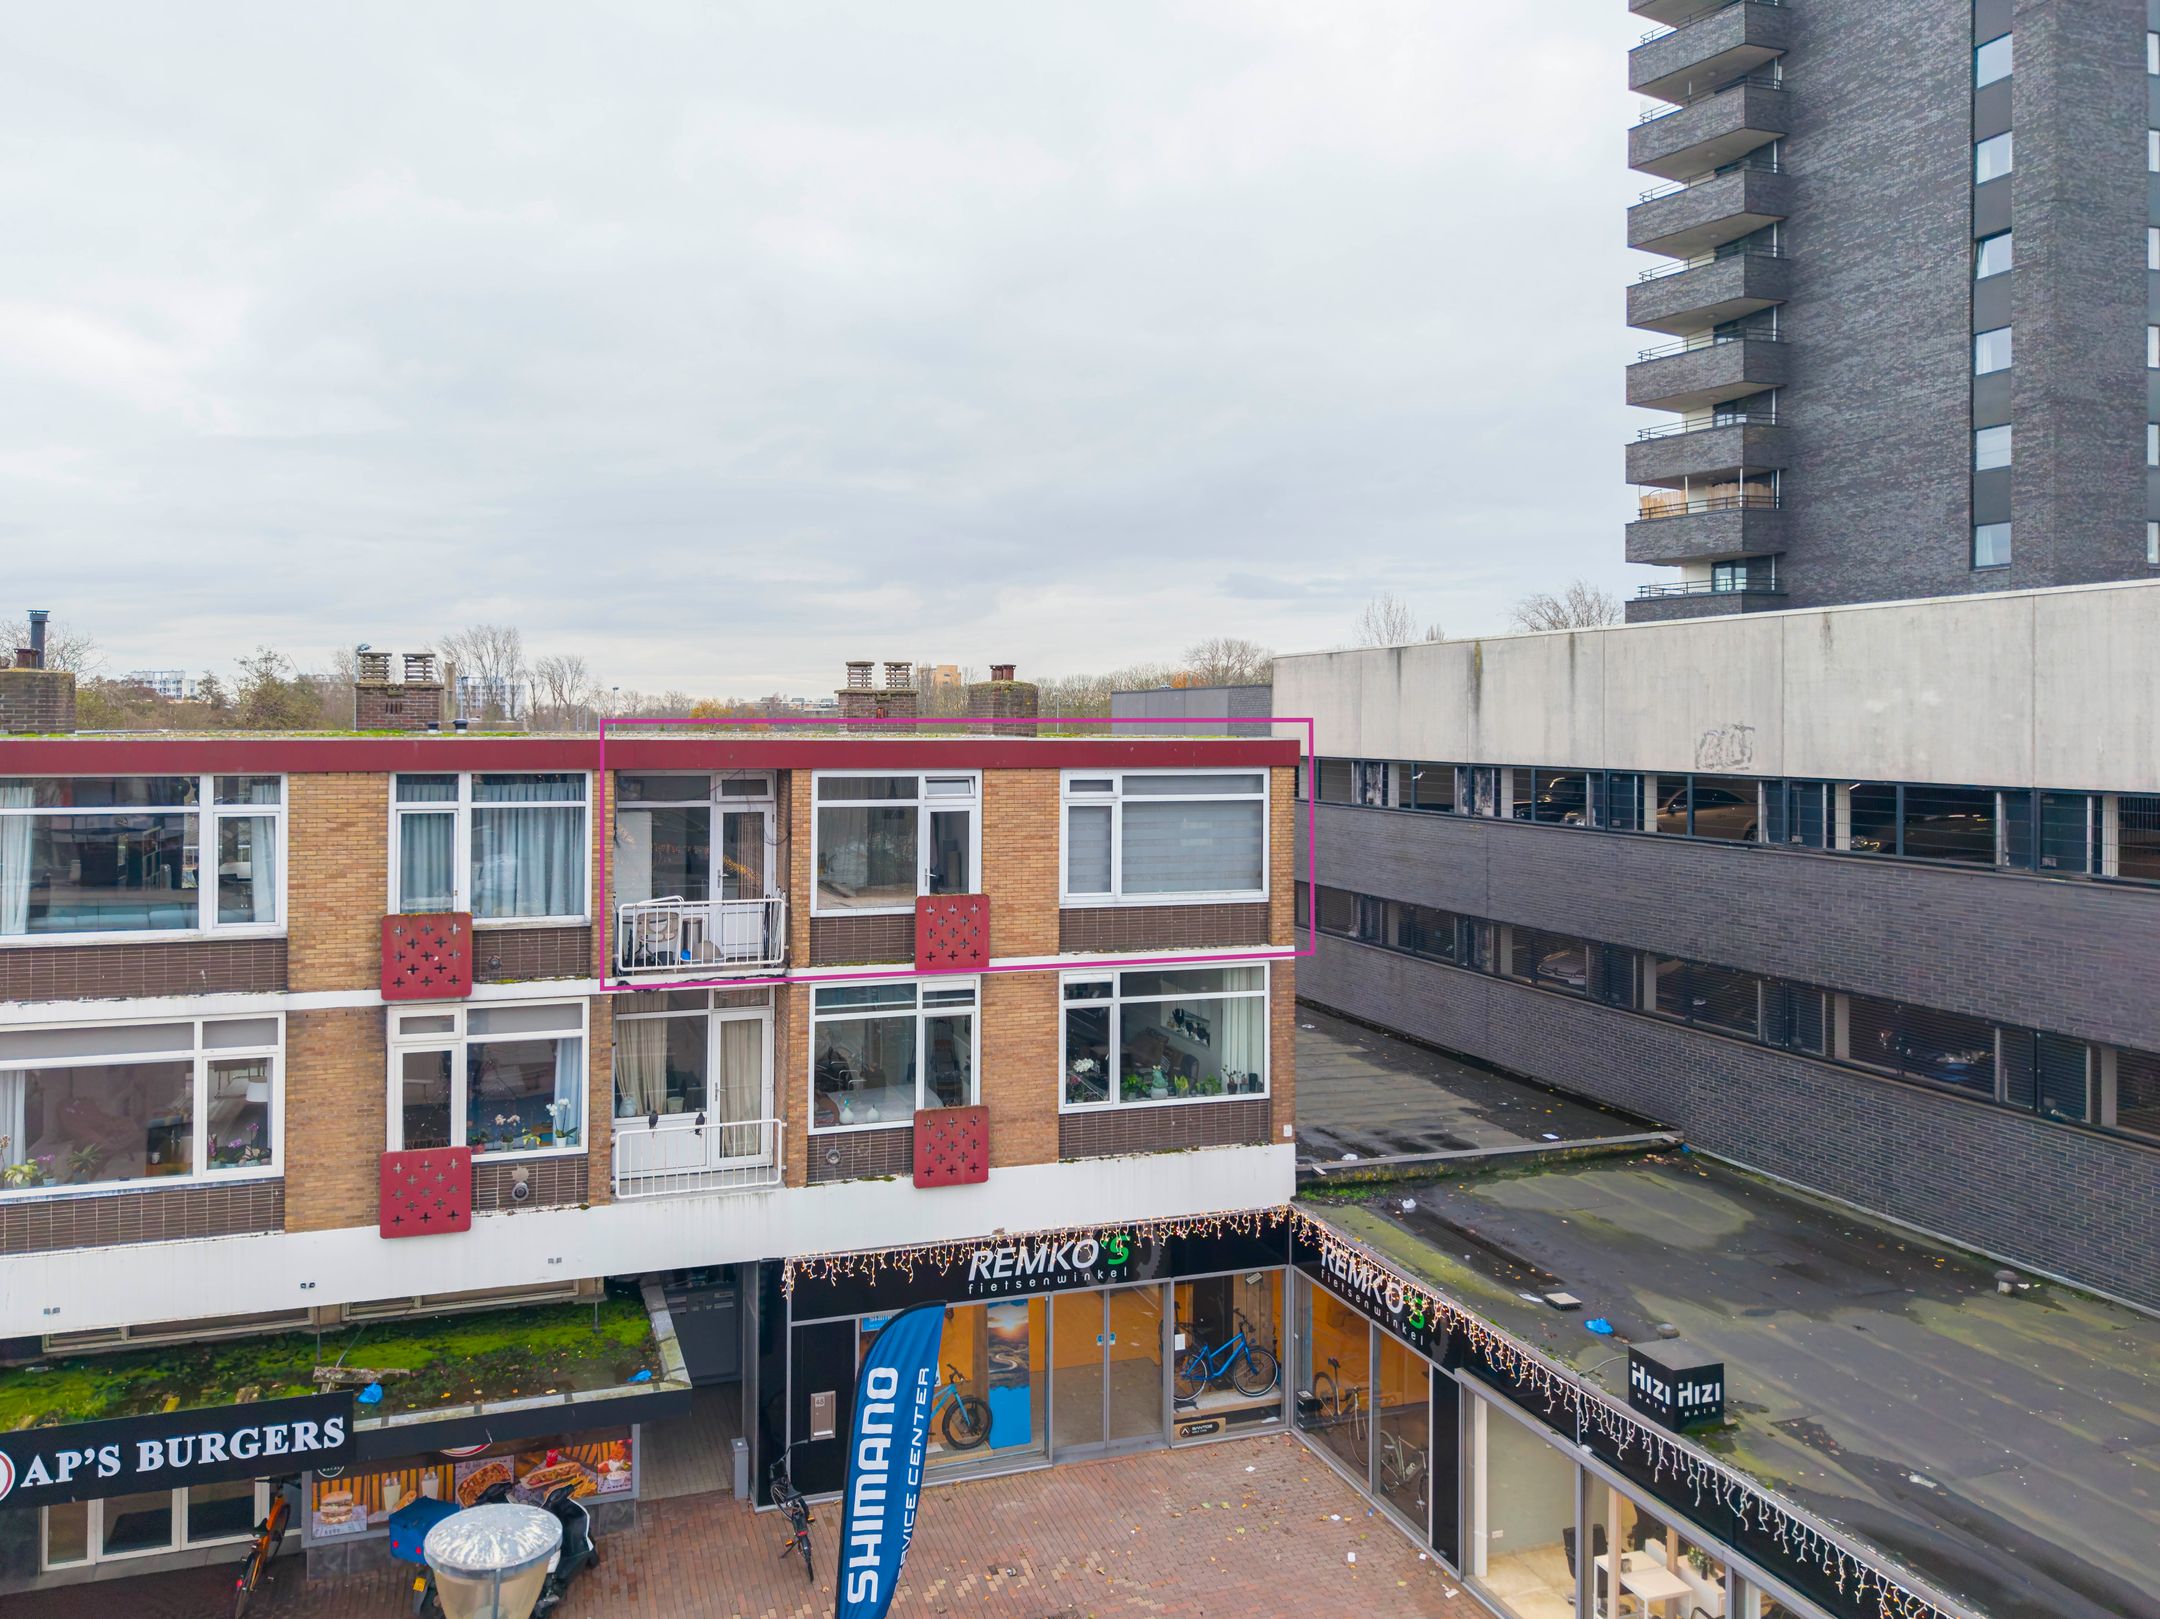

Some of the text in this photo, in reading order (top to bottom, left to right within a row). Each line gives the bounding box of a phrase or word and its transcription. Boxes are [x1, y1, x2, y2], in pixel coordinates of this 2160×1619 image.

[968, 1235, 1131, 1281] REMKO'S
[968, 1266, 1127, 1294] fietsenwinkel
[1321, 1272, 1424, 1346] fietsenwinkel
[1632, 1361, 1671, 1405] HIZI
[1637, 1392, 1667, 1414] HAIR
[1678, 1381, 1720, 1407] HIZI
[908, 1367, 930, 1486] CENTER
[1684, 1406, 1716, 1417] HAIR
[136, 1416, 345, 1473] BURGERS
[847, 1366, 899, 1603] SHIMANO
